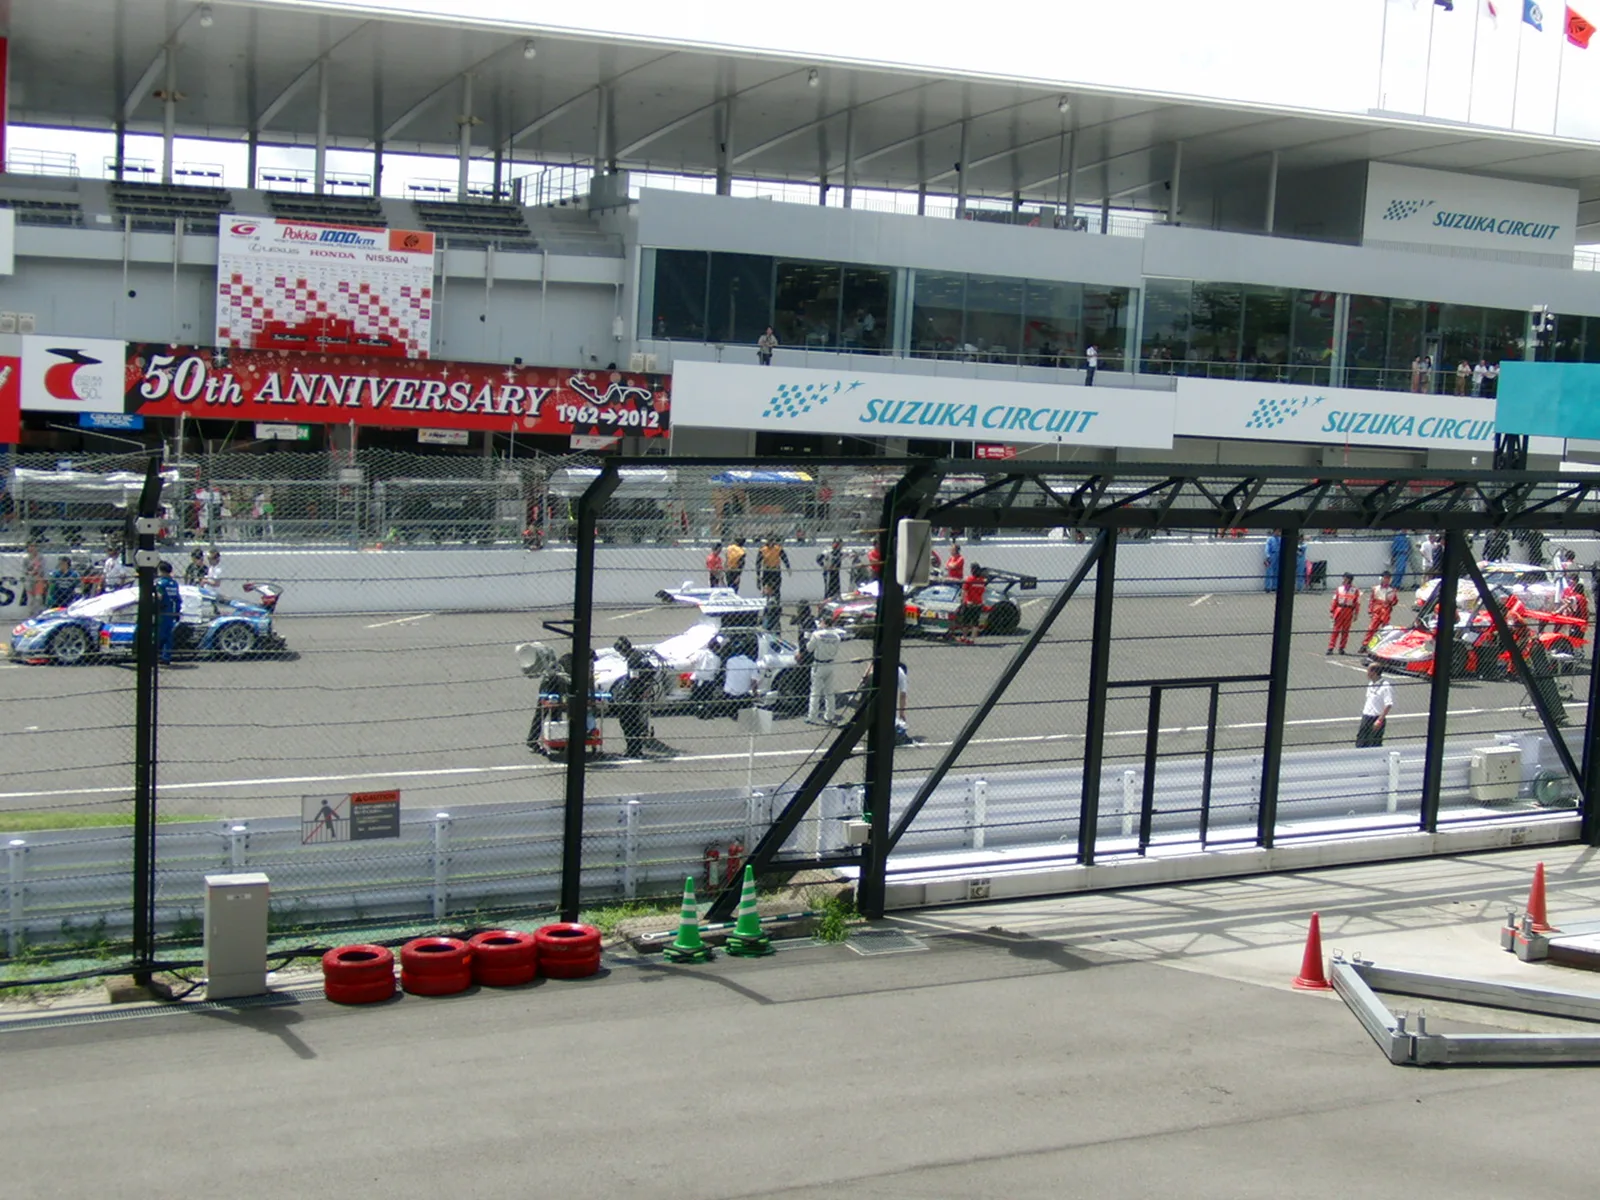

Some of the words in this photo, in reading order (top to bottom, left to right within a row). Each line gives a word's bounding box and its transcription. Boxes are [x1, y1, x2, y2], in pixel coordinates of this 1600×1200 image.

[282, 226, 318, 241] Pokka
[1432, 211, 1495, 233] SUZUKA
[1497, 219, 1560, 240] CIRCUIT
[309, 249, 356, 260] HONDA
[365, 253, 409, 264] NISSAN
[140, 354, 243, 404] 50th
[253, 371, 552, 416] ANNIVERSARY
[556, 404, 599, 424] 1962
[617, 408, 660, 428] 2012
[858, 398, 977, 428] SUZUKA
[981, 405, 1099, 433] CIRCUIT
[1322, 410, 1415, 437] SUZUKA
[1417, 416, 1496, 441] CIRCUI
